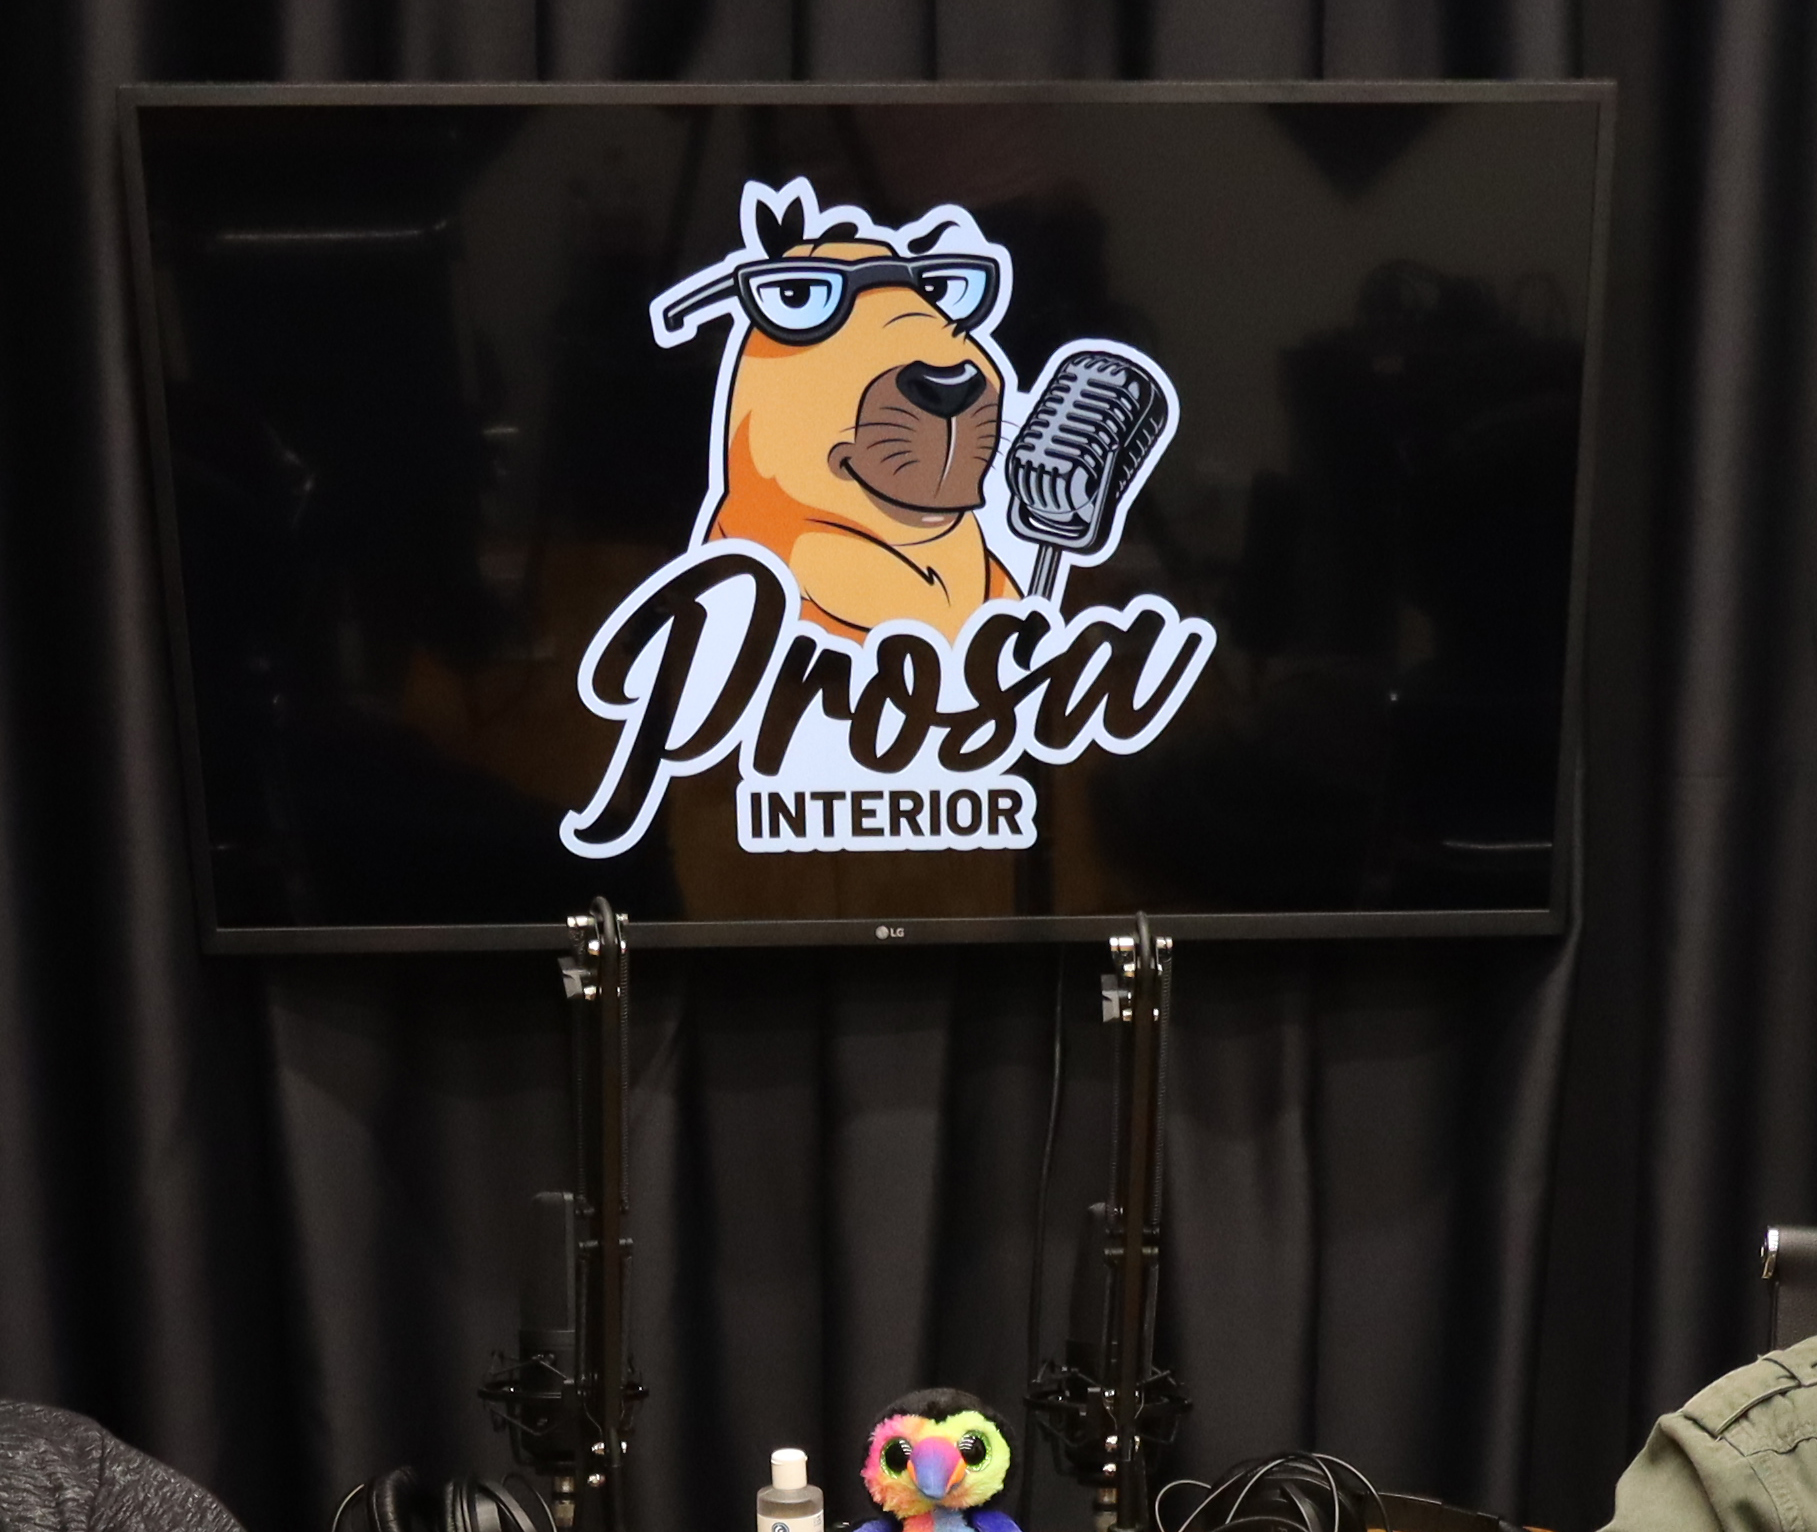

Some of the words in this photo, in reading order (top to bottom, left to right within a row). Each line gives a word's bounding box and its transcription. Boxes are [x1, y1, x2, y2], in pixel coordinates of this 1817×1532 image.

[573, 551, 1202, 846] Prosa
[751, 790, 1023, 838] INTERIOR
[890, 927, 905, 938] LG
